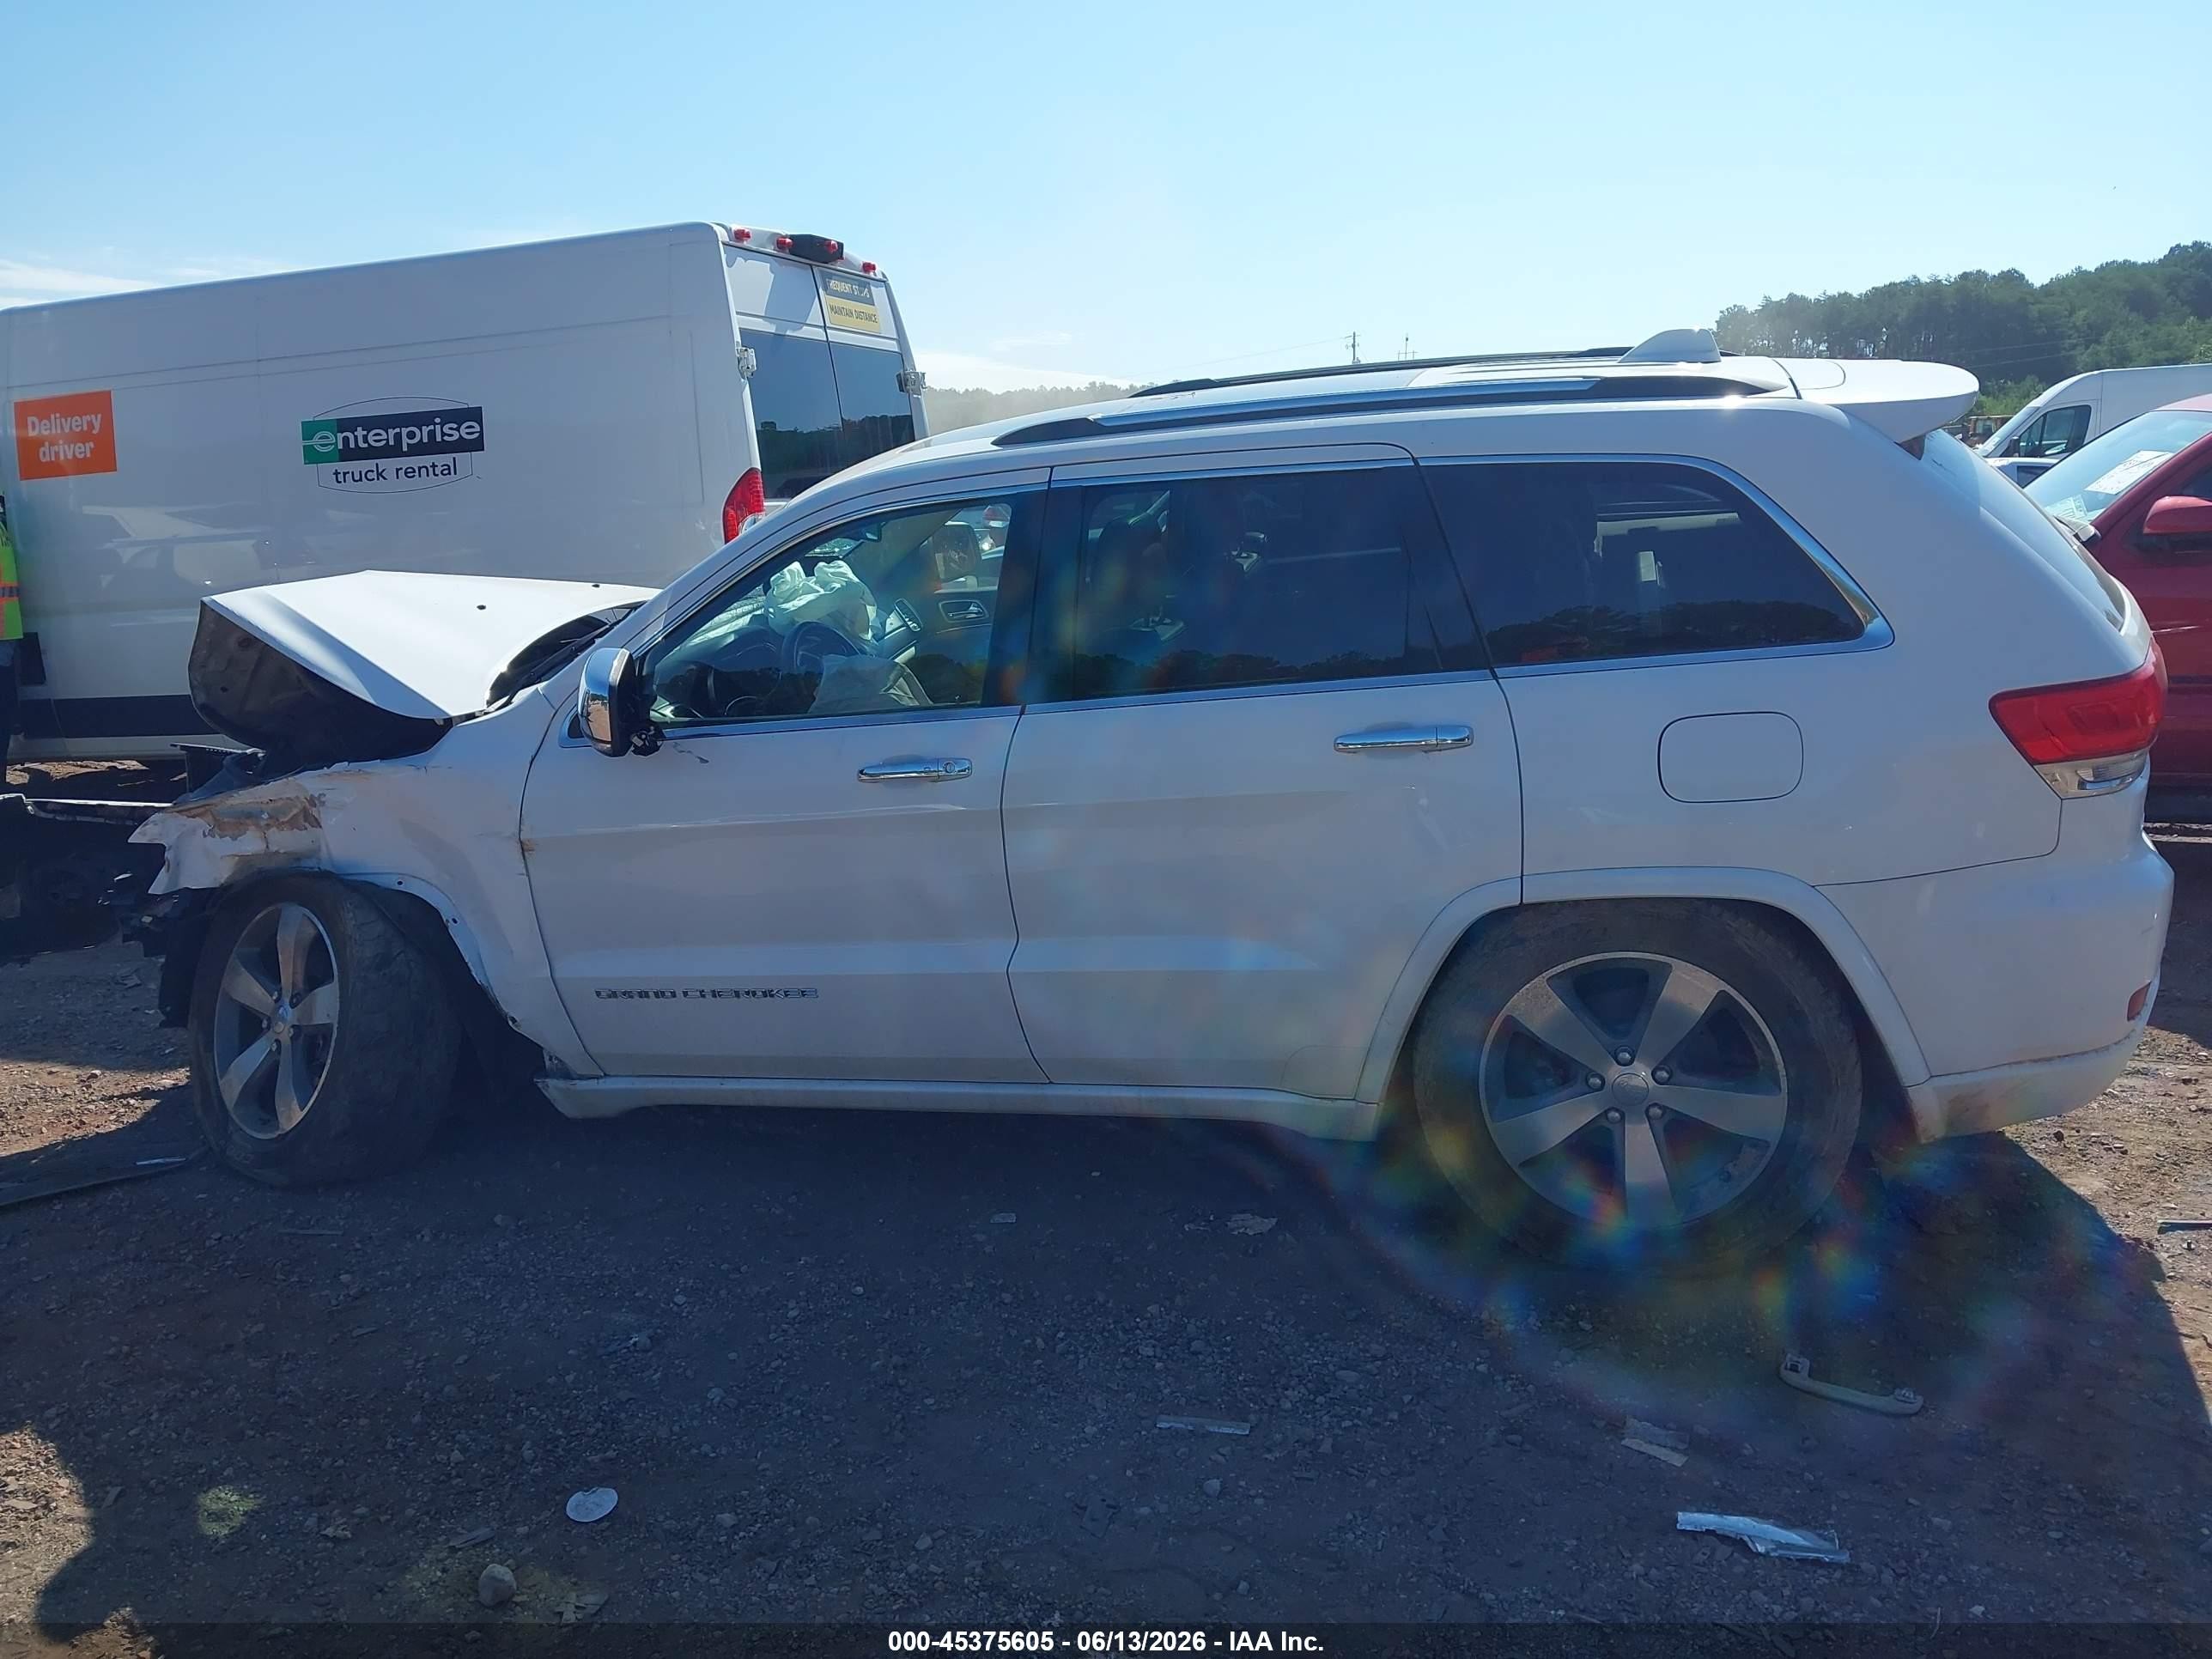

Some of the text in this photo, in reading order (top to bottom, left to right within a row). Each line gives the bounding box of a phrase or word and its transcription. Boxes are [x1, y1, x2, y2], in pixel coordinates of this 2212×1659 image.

[829, 303, 878, 324] MAINTAIN DISTANCE
[27, 413, 102, 437] Delivery
[302, 417, 481, 452] enterprise
[39, 440, 94, 462] driver
[332, 457, 458, 483] truck rental
[595, 988, 819, 999] GRAND CHEROKEE
